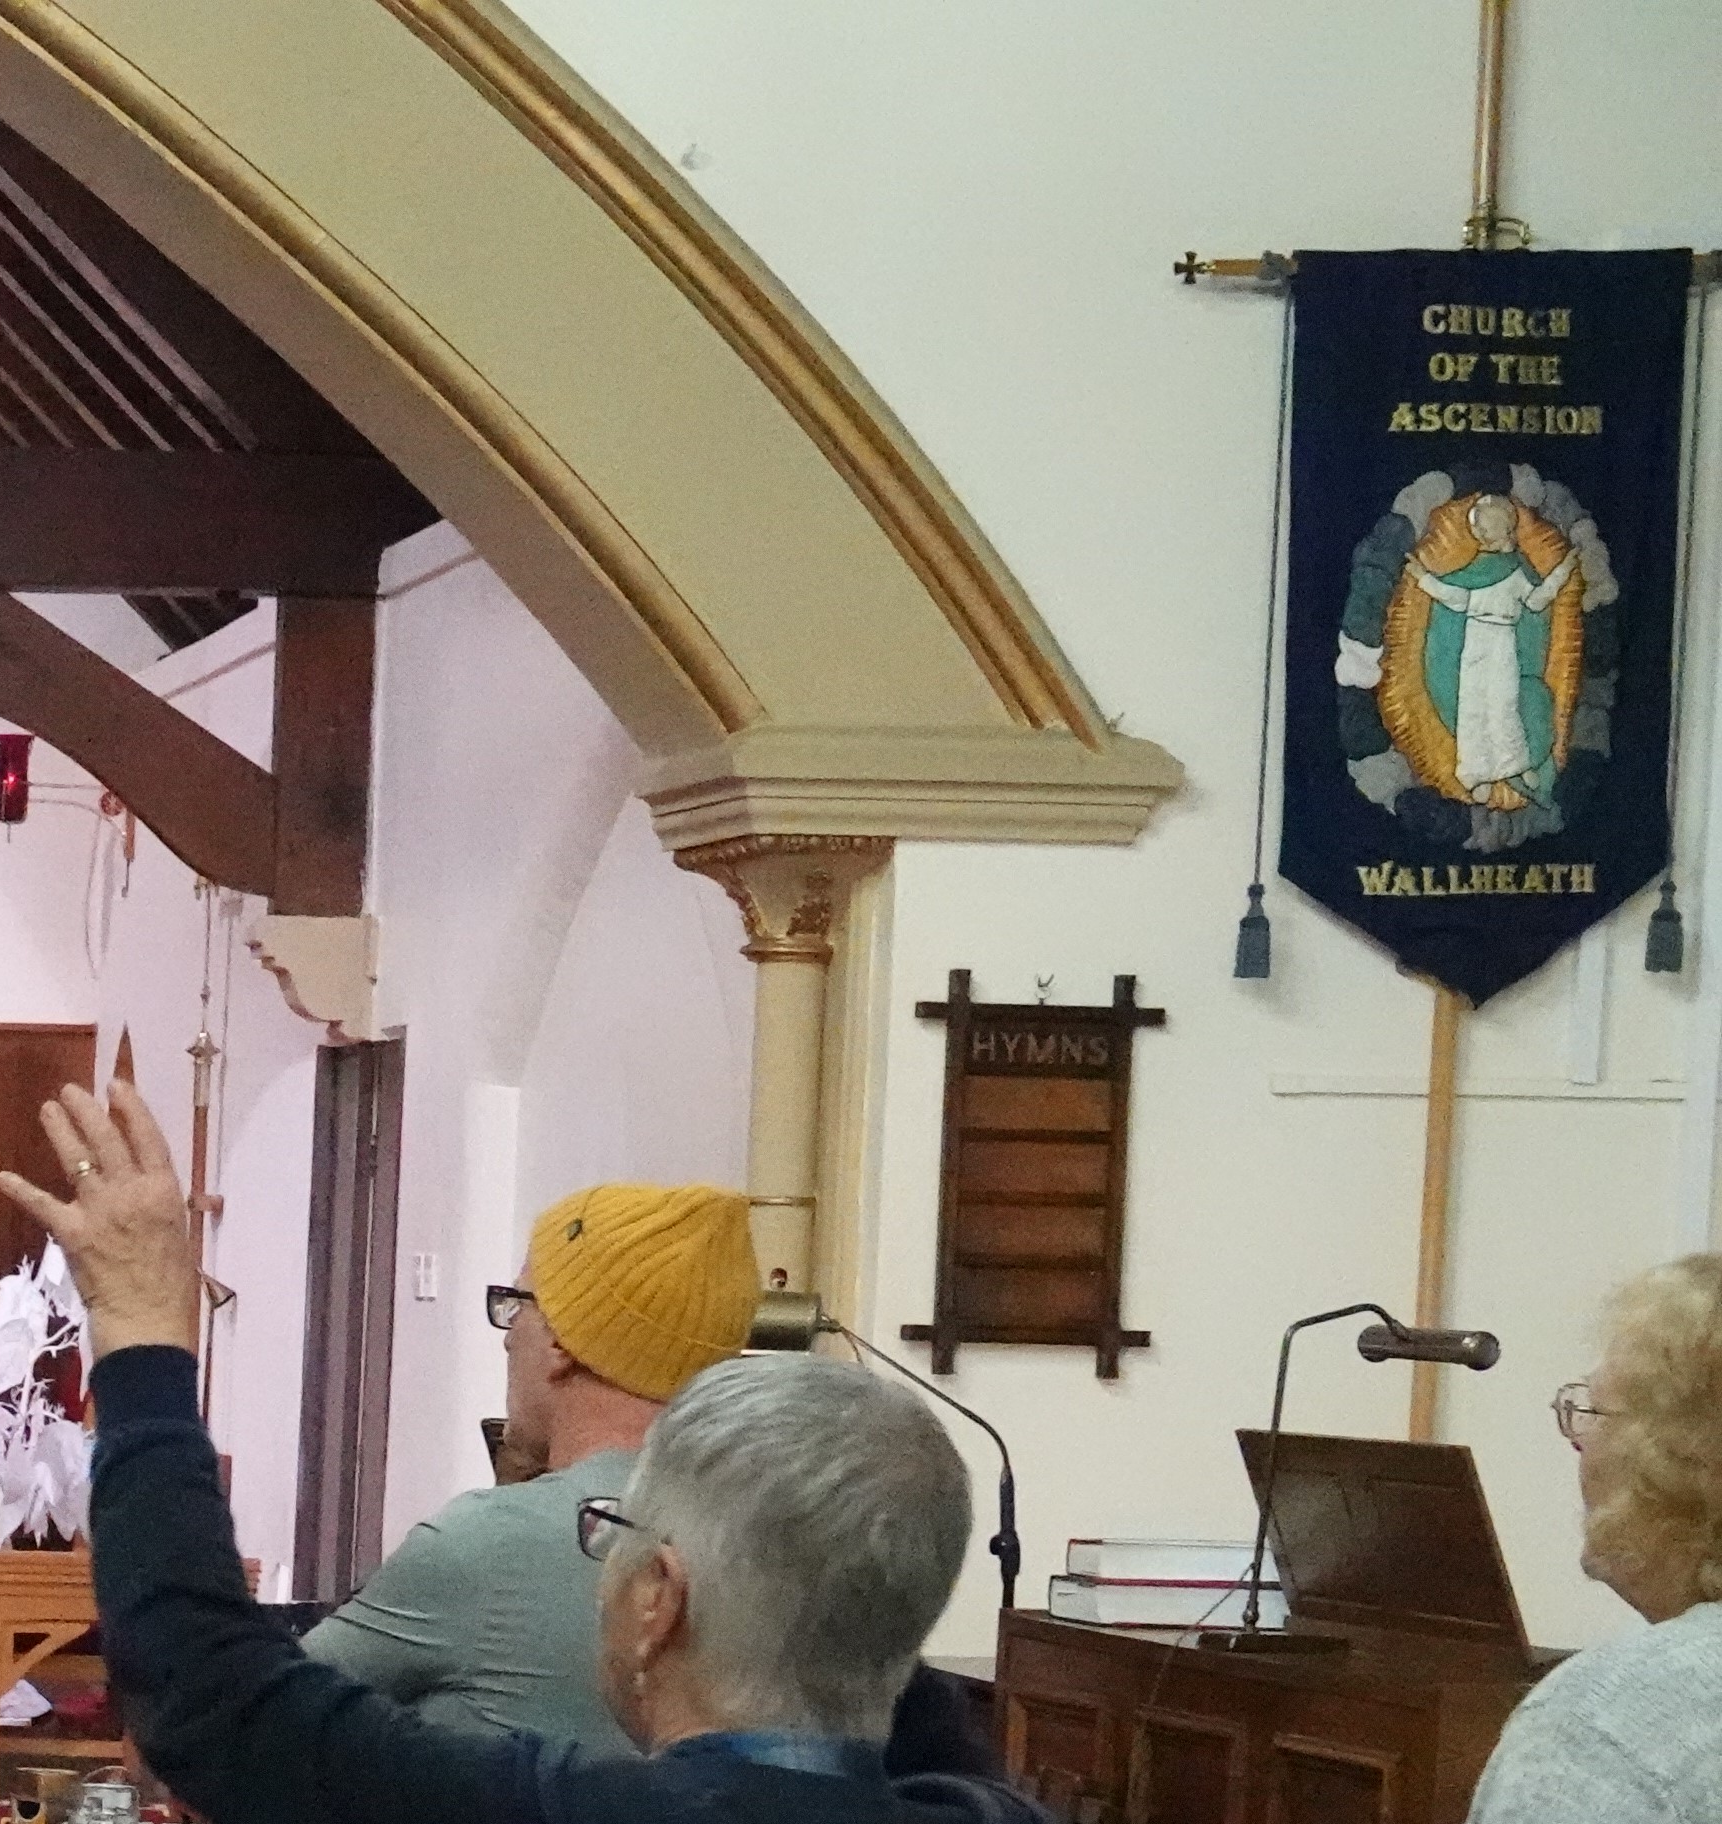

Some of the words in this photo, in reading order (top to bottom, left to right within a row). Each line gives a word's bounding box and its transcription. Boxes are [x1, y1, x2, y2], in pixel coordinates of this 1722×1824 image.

[1422, 303, 1572, 338] CHURCH
[1428, 352, 1479, 382] OF
[1490, 353, 1563, 386] THE
[1388, 402, 1603, 435] ASCENSION
[1355, 860, 1596, 897] WALLHEATH
[972, 1031, 1109, 1065] HYMNS
